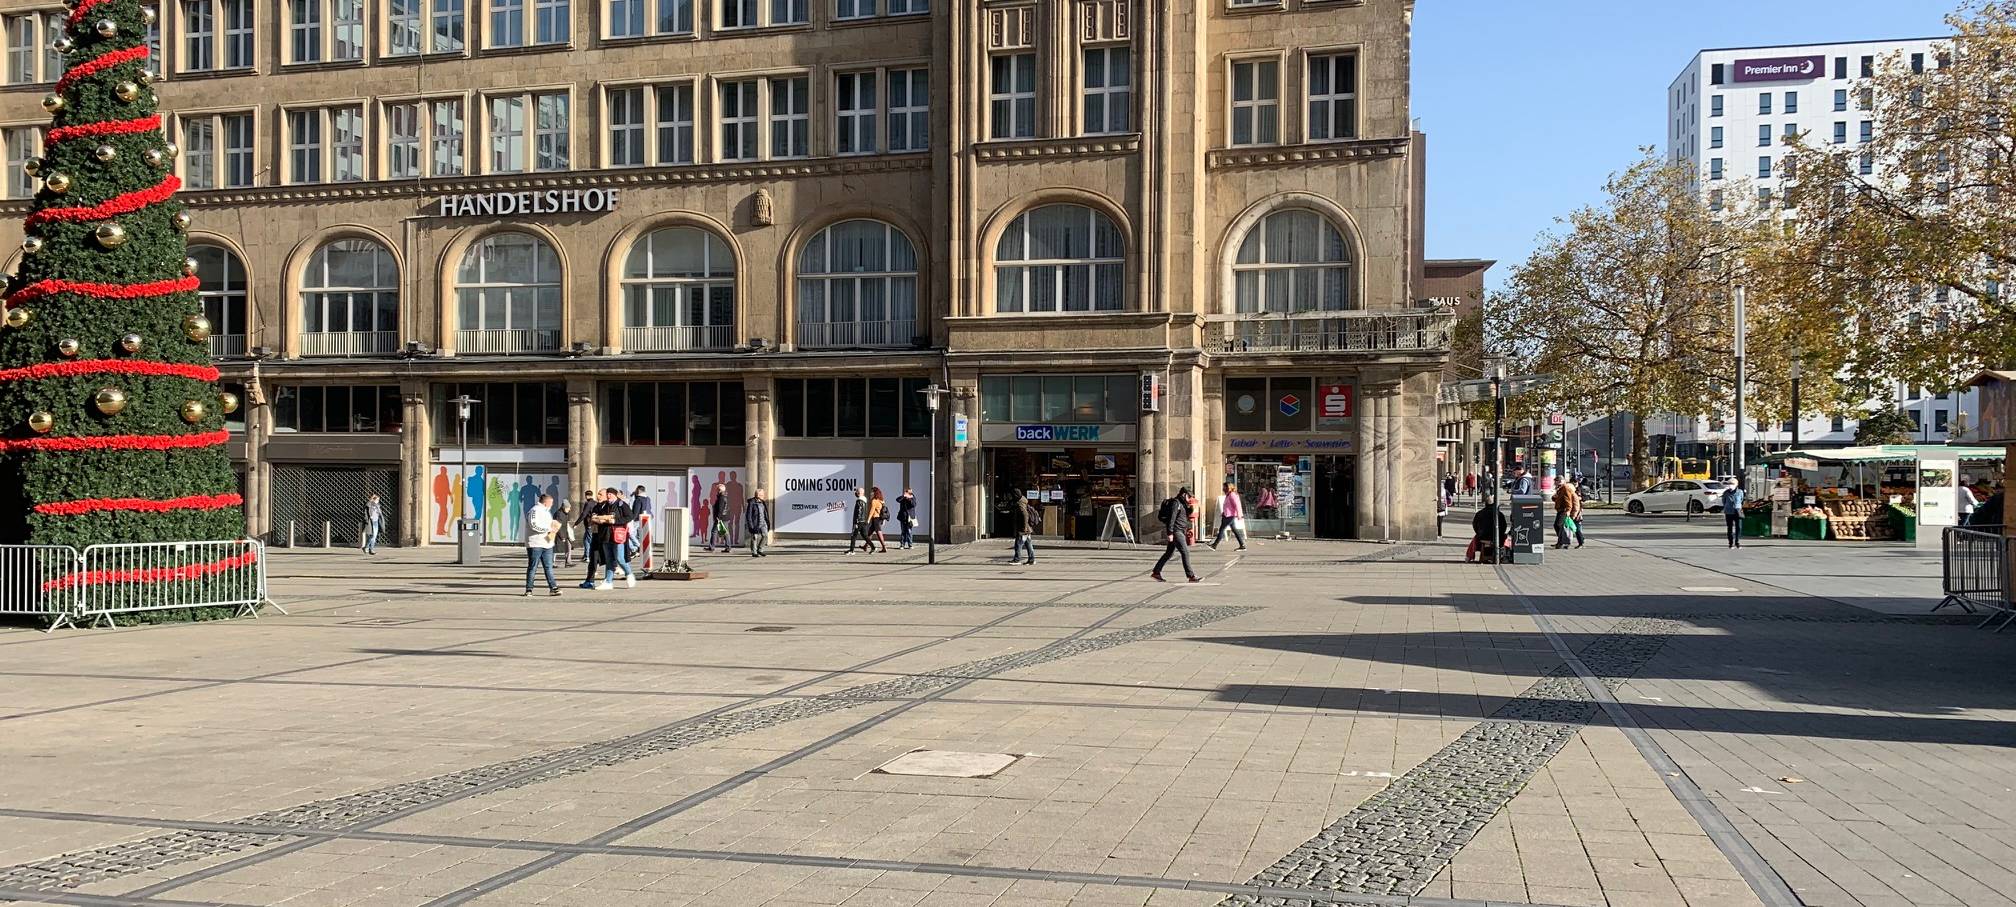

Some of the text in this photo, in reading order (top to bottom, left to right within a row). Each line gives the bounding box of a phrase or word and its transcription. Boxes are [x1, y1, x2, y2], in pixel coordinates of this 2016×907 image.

[1744, 63, 1798, 75] Premier Inn
[440, 188, 620, 217] HANDELSHOF
[785, 478, 857, 491] COMING SOON!
